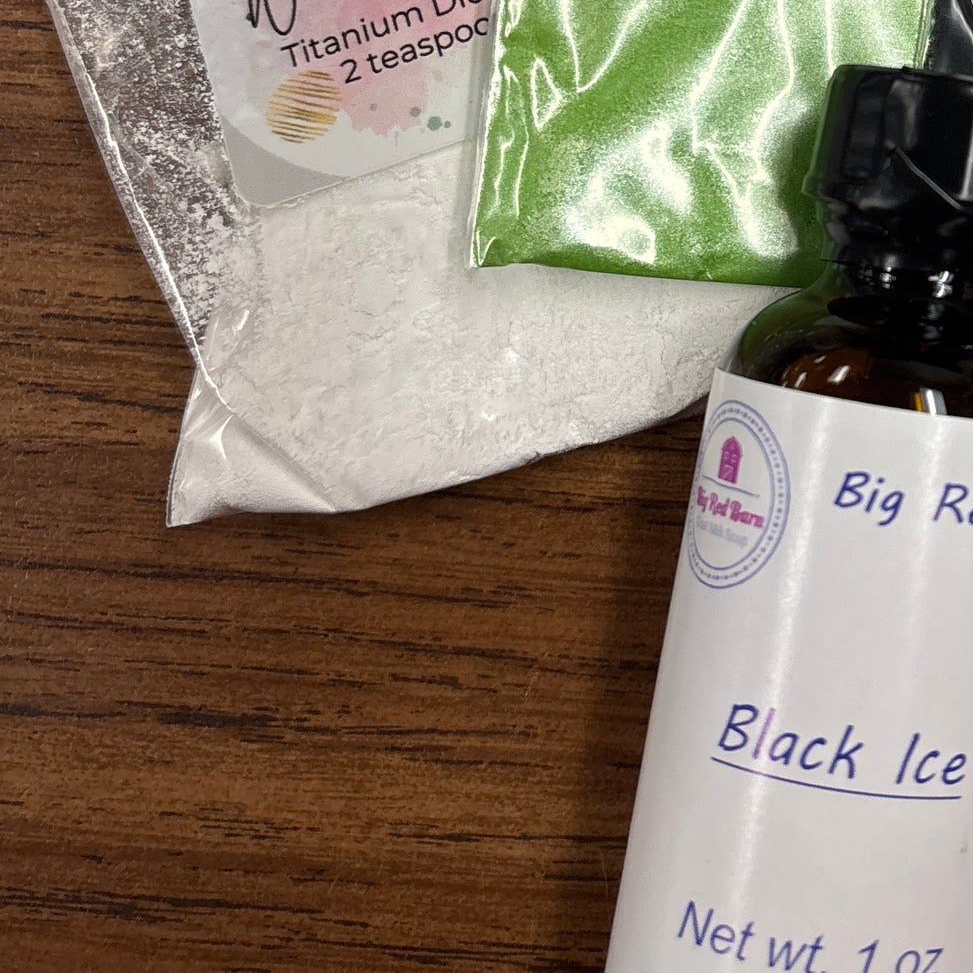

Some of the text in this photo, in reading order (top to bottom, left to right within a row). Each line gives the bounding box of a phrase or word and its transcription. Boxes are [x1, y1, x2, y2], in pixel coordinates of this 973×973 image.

[280, 6, 424, 67] Titanium
[340, 58, 362, 84] 2
[729, 500, 764, 529] Barn
[834, 470, 905, 526] Big
[718, 703, 967, 785] Black Ice
[677, 900, 755, 961] Net
[858, 939, 880, 973] 1
